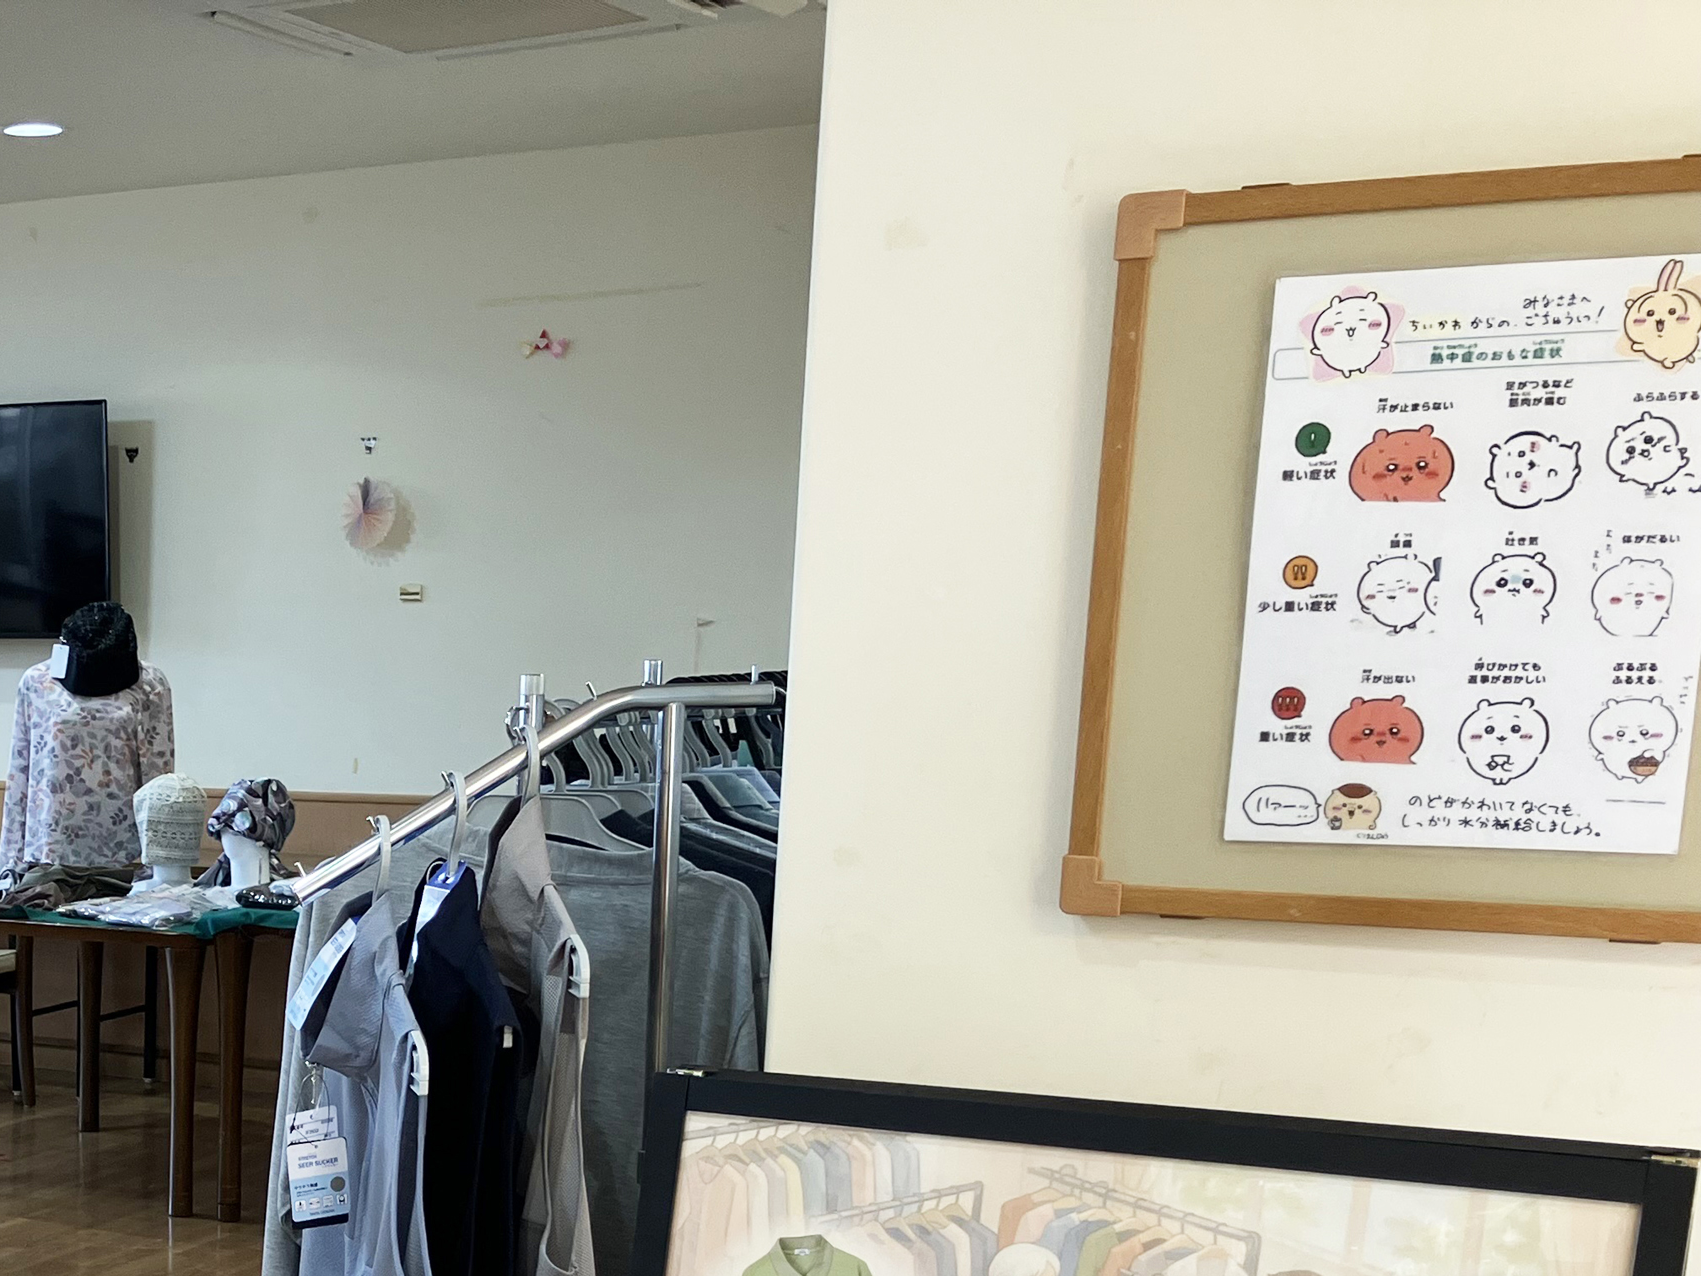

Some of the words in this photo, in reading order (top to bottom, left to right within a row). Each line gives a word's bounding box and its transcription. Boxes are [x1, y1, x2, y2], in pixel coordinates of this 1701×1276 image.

[1505, 378, 1574, 391] 足がつるなど
[1633, 391, 1700, 402] ふらふらする
[1376, 402, 1454, 414] 汗が止まらない
[1505, 536, 1539, 547] 吐き気
[1257, 600, 1337, 613] 少し重い症状
[1474, 661, 1541, 672] 呼びかけても
[1361, 675, 1416, 684] 汗が出ない
[1468, 675, 1547, 685] 返事がおかしい
[1258, 731, 1311, 743] 重い症状
